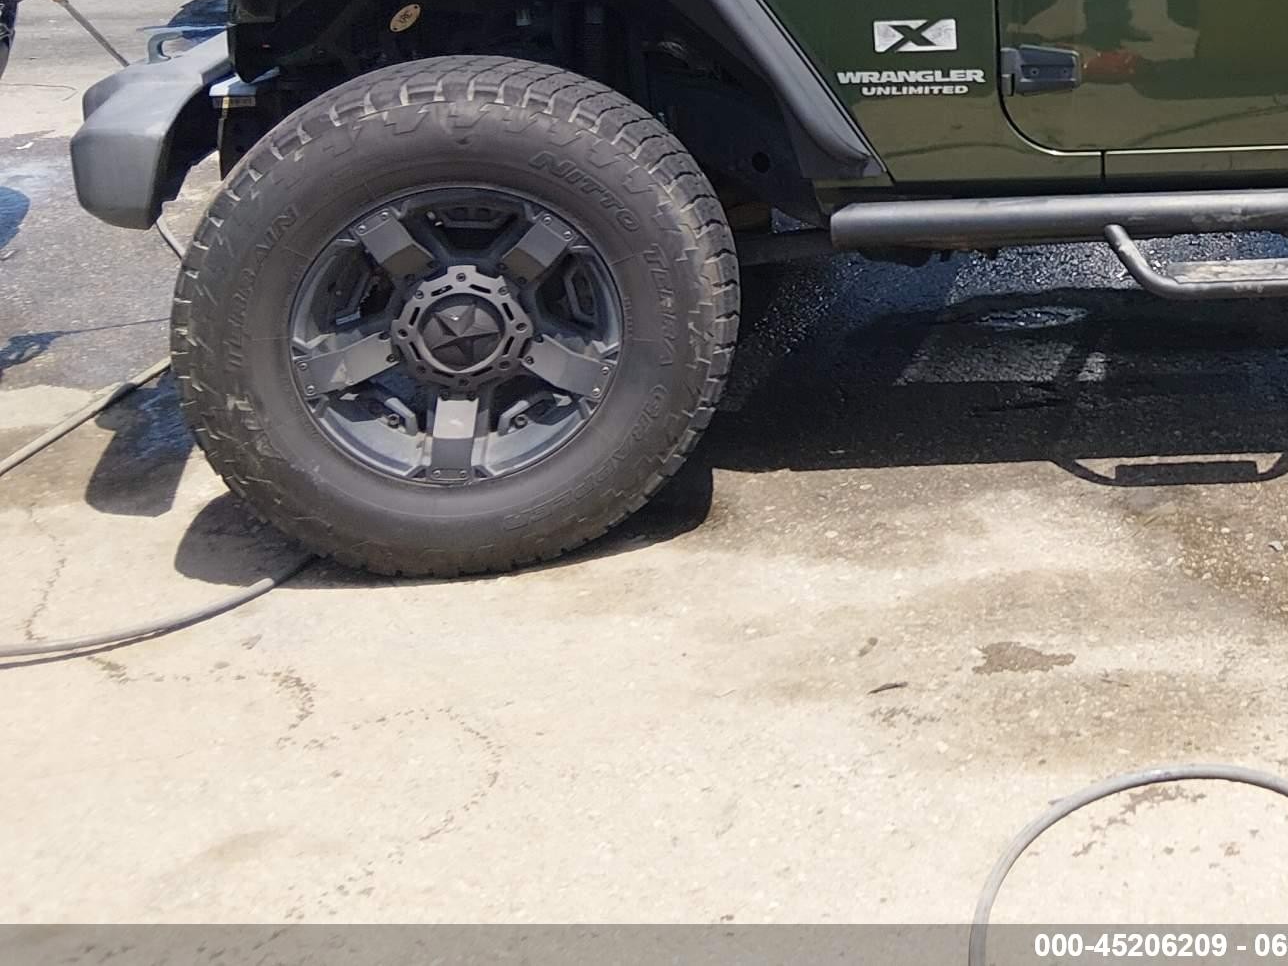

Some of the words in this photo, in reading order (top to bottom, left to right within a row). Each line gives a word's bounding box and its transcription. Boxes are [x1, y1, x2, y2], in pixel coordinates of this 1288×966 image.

[836, 68, 986, 84] WRANGLER
[861, 85, 969, 97] UNLIMITED
[528, 150, 641, 232] NITTO
